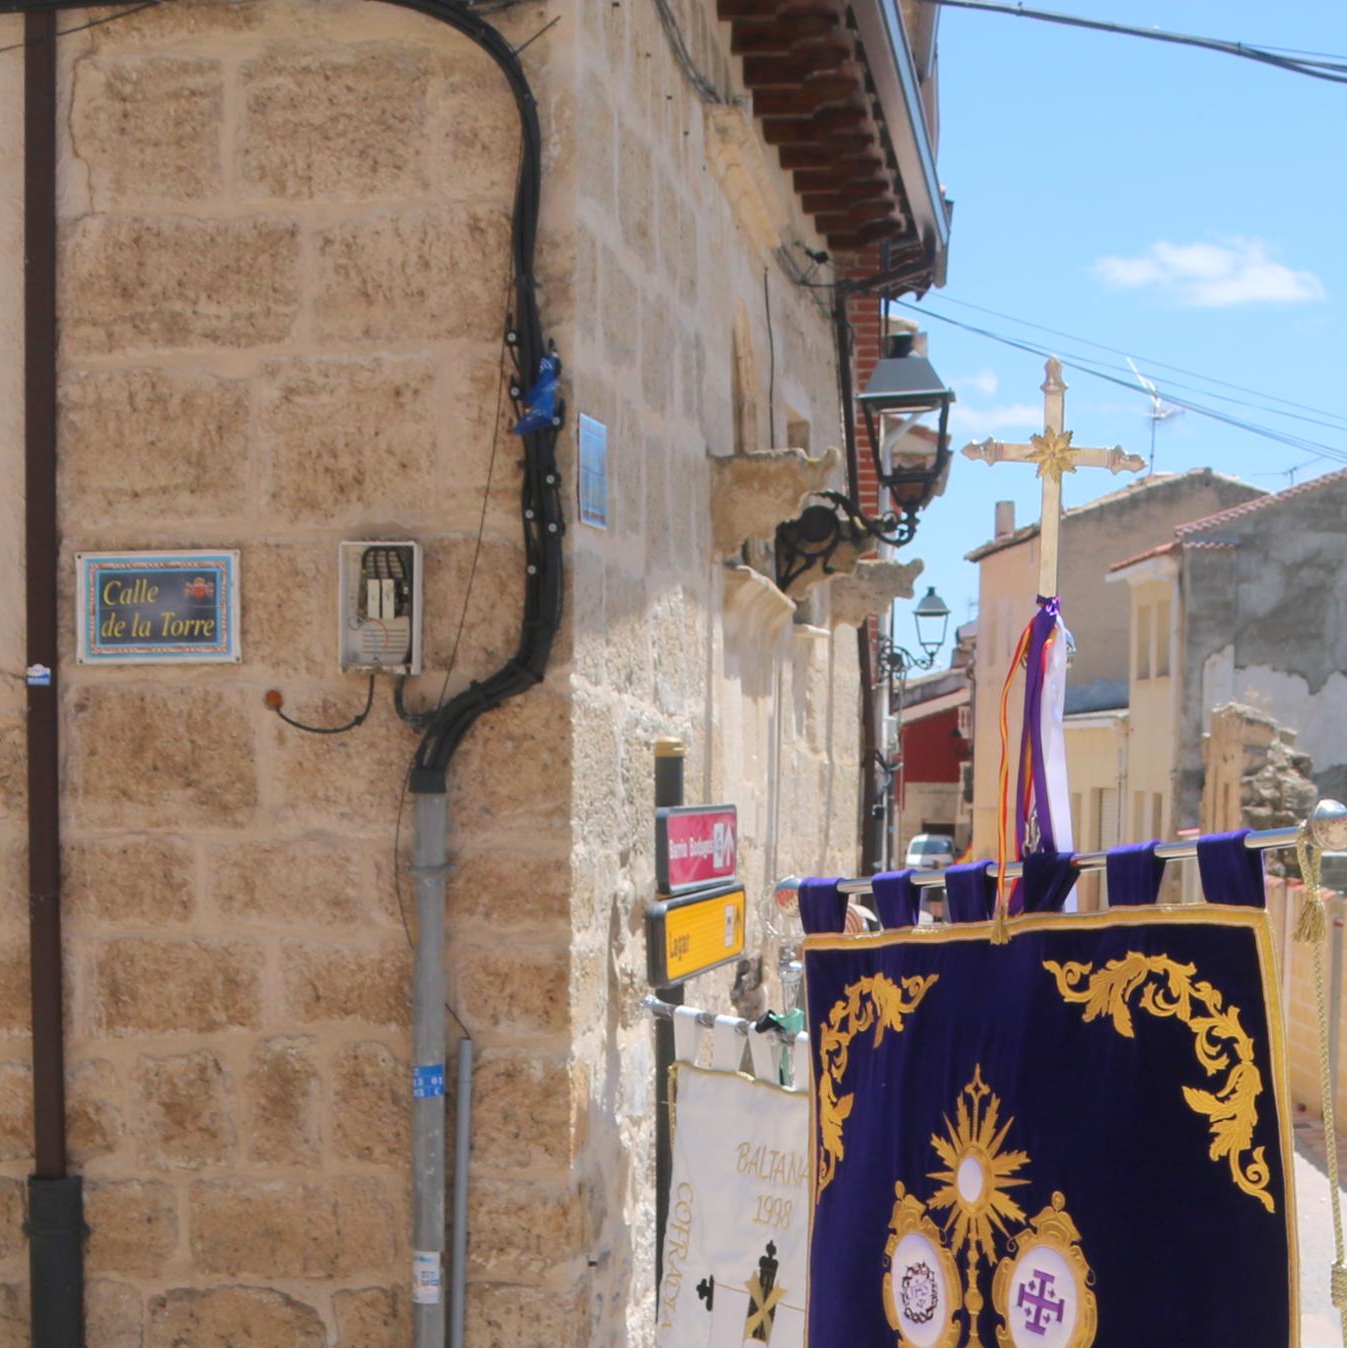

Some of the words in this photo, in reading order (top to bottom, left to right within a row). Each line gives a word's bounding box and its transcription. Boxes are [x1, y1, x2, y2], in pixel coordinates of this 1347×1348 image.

[102, 578, 159, 606] Calle
[100, 611, 126, 638] de
[131, 612, 152, 638] la
[160, 611, 215, 638] Torre
[751, 1193, 794, 1231] 1998
